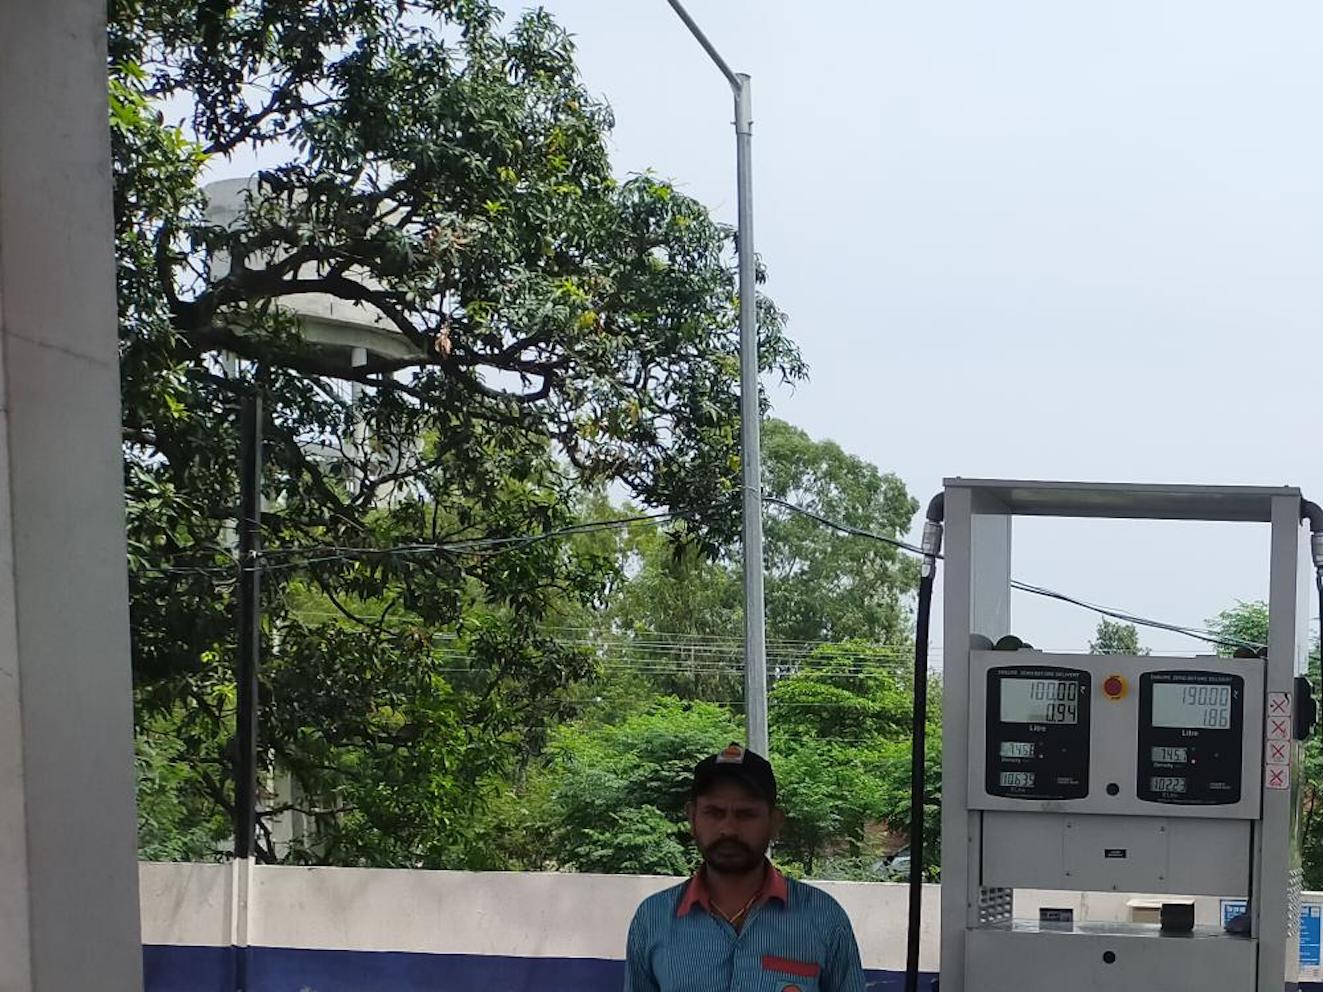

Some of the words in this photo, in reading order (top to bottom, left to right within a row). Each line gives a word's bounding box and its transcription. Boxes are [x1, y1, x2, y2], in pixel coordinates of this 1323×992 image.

[1029, 681, 1076, 701] 100.00
[1182, 686, 1229, 706] 190.00
[1045, 703, 1076, 722] 0.94
[1181, 729, 1199, 737] Litre
